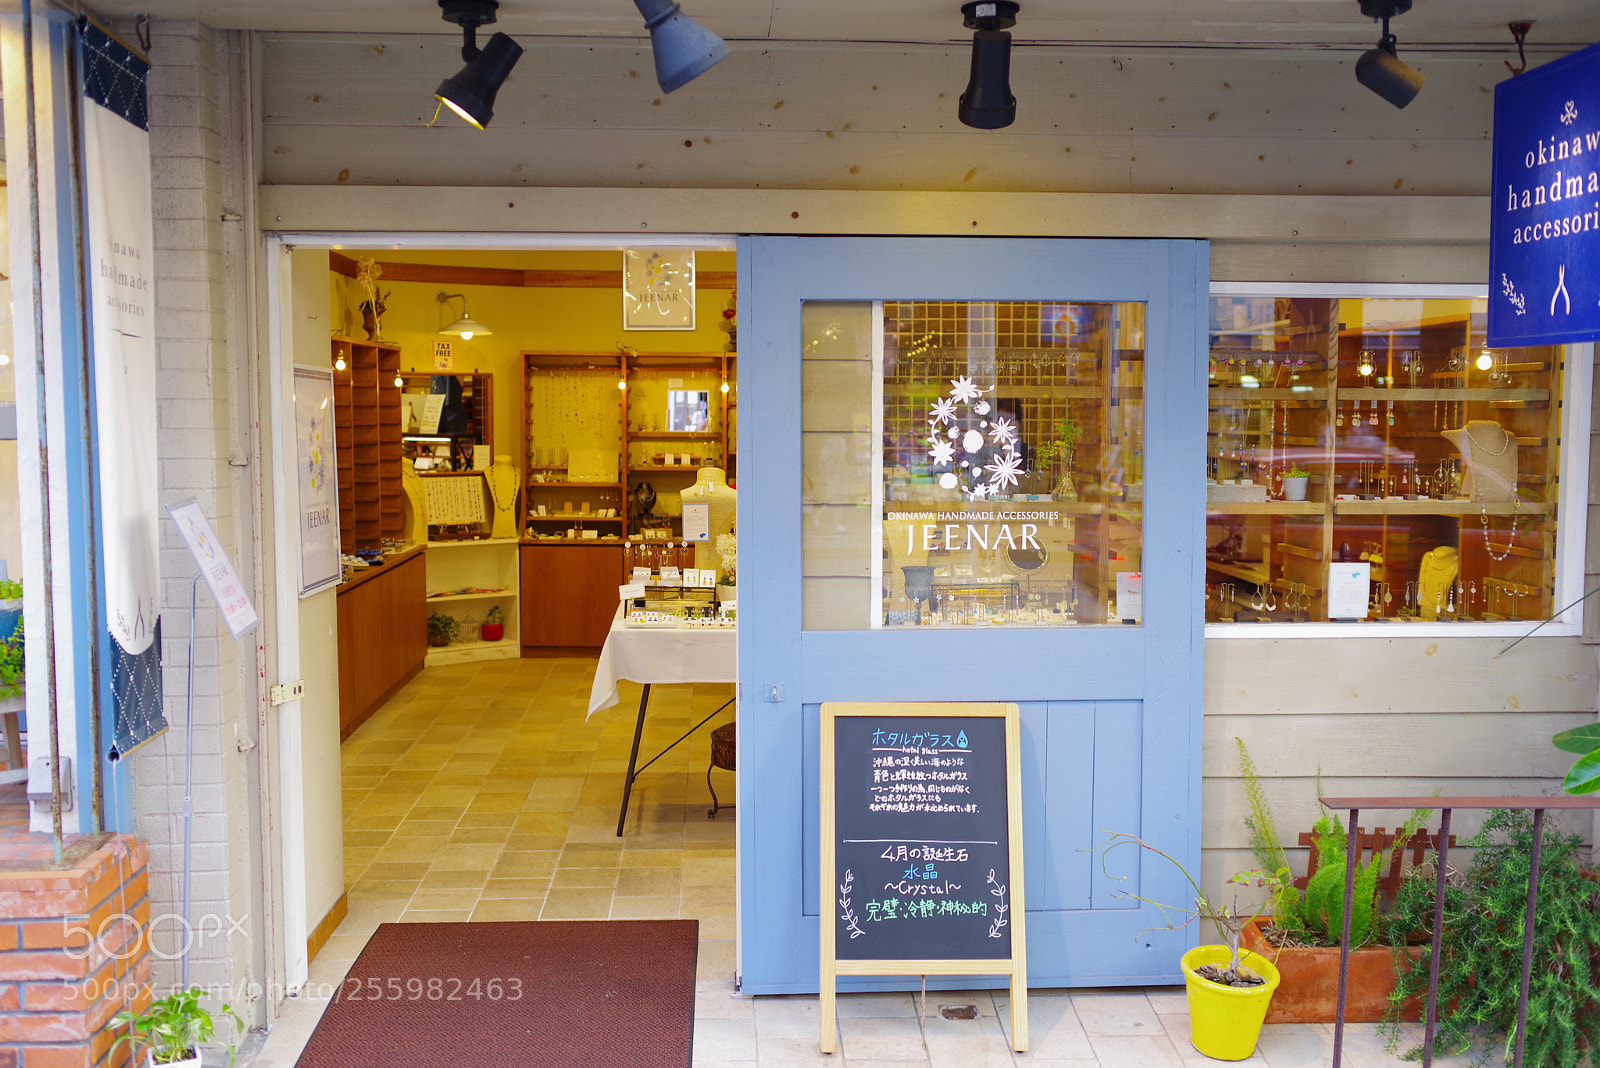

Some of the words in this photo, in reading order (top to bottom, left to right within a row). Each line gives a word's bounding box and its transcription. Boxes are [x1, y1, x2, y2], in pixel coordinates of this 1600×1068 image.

[1525, 131, 1600, 168] okinaw
[1507, 171, 1600, 211] handma
[1513, 201, 1600, 244] accessori
[639, 293, 678, 302] JEENAR
[436, 342, 450, 350] TAX
[307, 508, 331, 532] JEENAR
[887, 511, 935, 521] OKINAWA
[937, 511, 994, 521] HANDMADE
[997, 511, 1059, 521] ACCESSORIES
[907, 523, 1041, 556] JEENAR
[872, 727, 955, 747] ホタルガラス
[872, 755, 964, 767] 沖縄の深く美しい海のような
[873, 769, 968, 783] 青色と輝きを放つホタルガラス
[874, 793, 941, 802] どのホタルガラスにも
[880, 845, 969, 862] 4月の誕生石
[902, 863, 938, 880] 水晶
